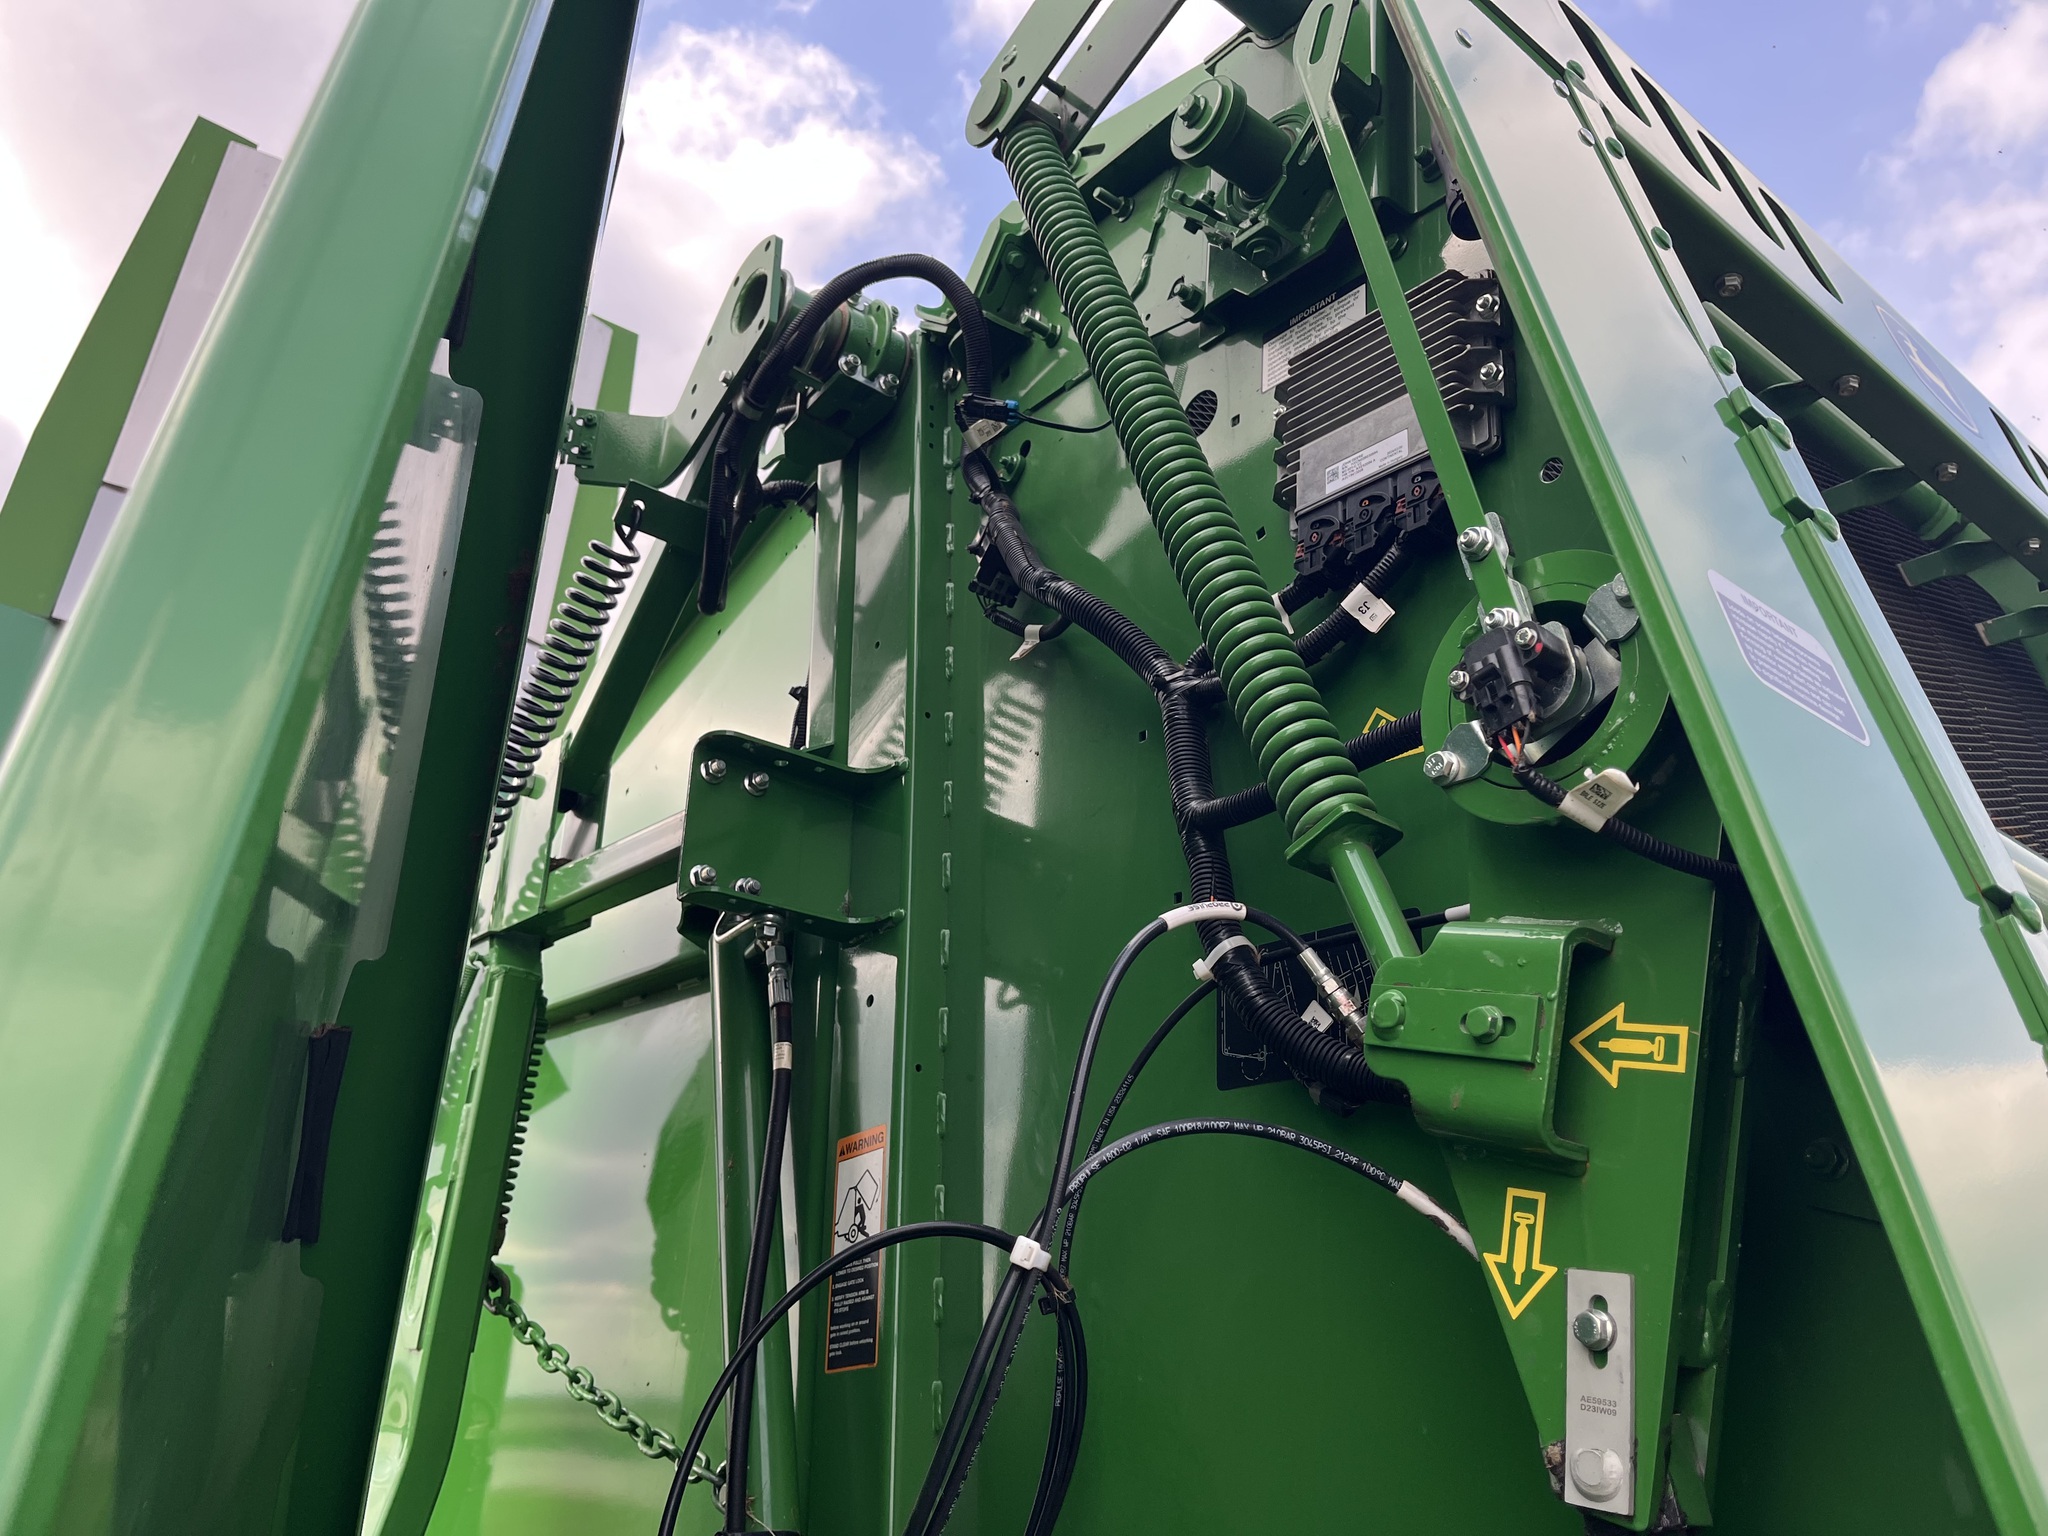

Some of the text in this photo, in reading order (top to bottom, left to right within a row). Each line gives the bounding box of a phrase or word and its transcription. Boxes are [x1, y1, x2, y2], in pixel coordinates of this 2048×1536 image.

[1289, 292, 1337, 326] IMPORTANT
[1358, 601, 1370, 615] J3
[1593, 799, 1606, 809] SIZE
[1094, 1128, 1105, 1143] MADE
[1102, 1117, 1110, 1126] IN
[1107, 1105, 1117, 1117] USA
[845, 1131, 884, 1155] WARNING
[1299, 1135, 1332, 1155] 3045PSI
[1065, 1212, 1075, 1236] 210BAR
[1580, 1395, 1617, 1408] AE59533
